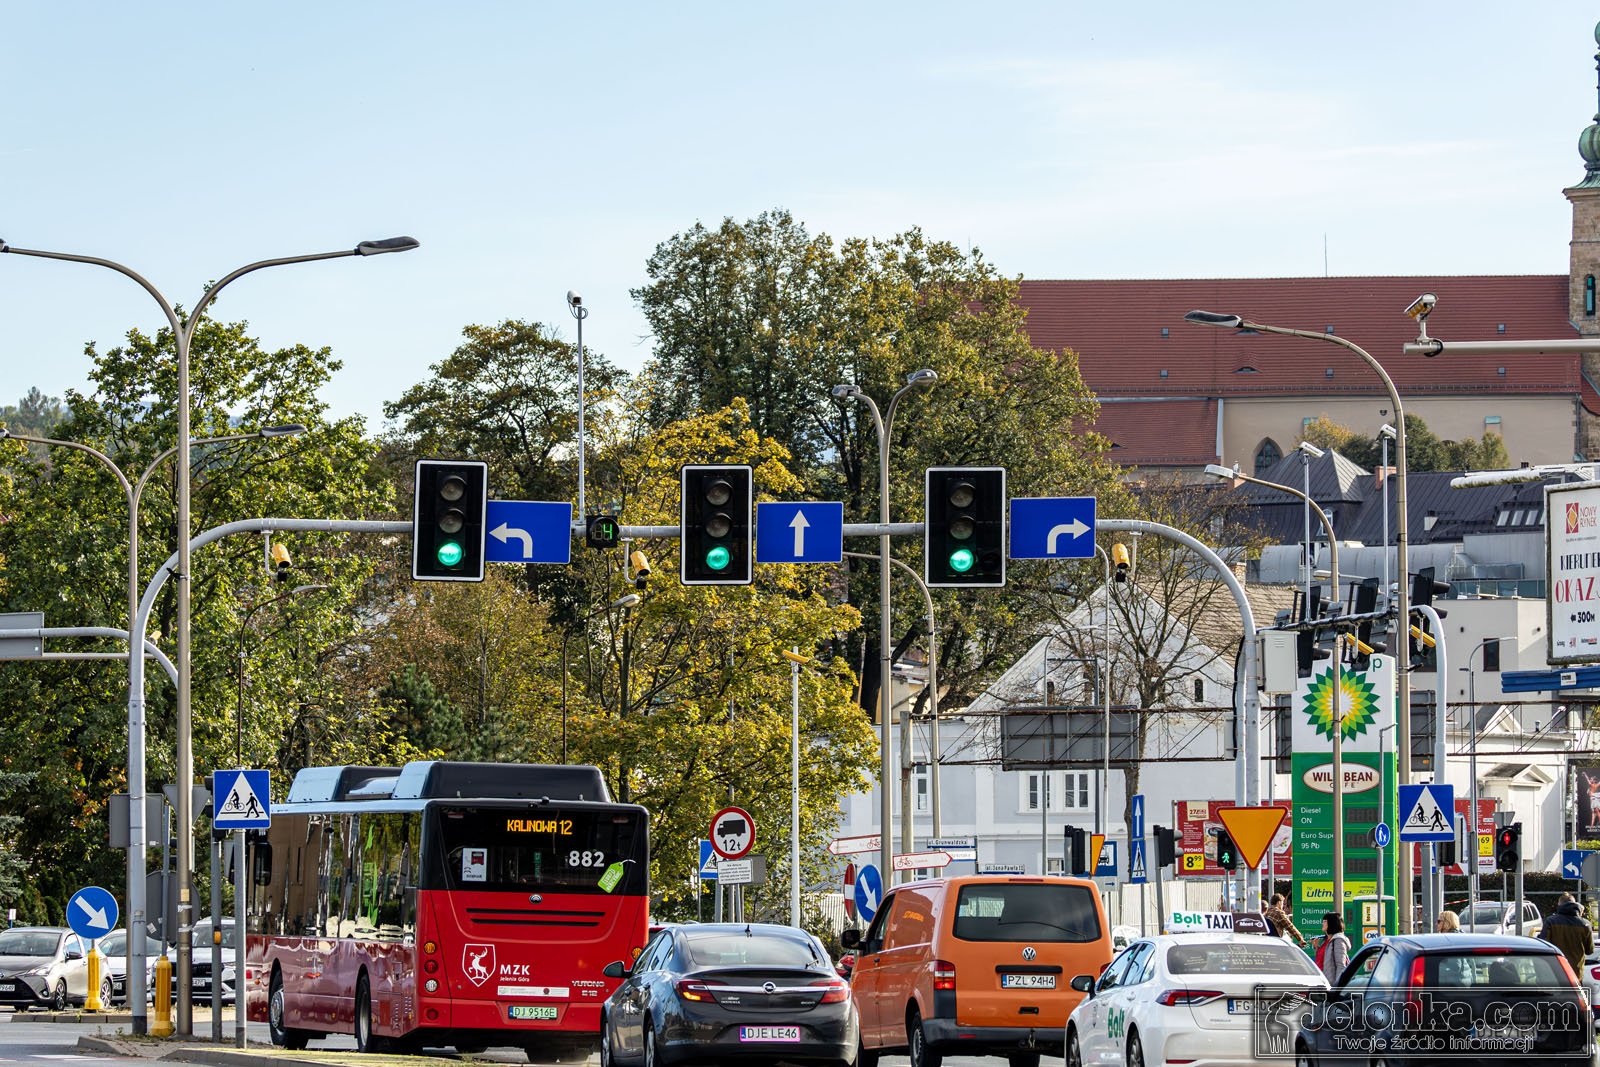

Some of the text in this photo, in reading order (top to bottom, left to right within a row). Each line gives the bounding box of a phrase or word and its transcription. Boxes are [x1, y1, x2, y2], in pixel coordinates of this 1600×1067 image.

[1580, 506, 1597, 517] NOWY
[1312, 772, 1373, 782] WIL BEAN
[507, 820, 573, 836] KALINOWA 12
[569, 851, 605, 868] 882
[1301, 867, 1329, 875] Autogaz
[1173, 912, 1203, 927] Bolt
[1205, 914, 1233, 929] TAXI
[500, 964, 530, 975] MZK
[1008, 976, 1054, 986] PZL 94H4
[515, 1007, 555, 1017] DJ 9516E
[747, 1028, 797, 1039] DJE LE46
